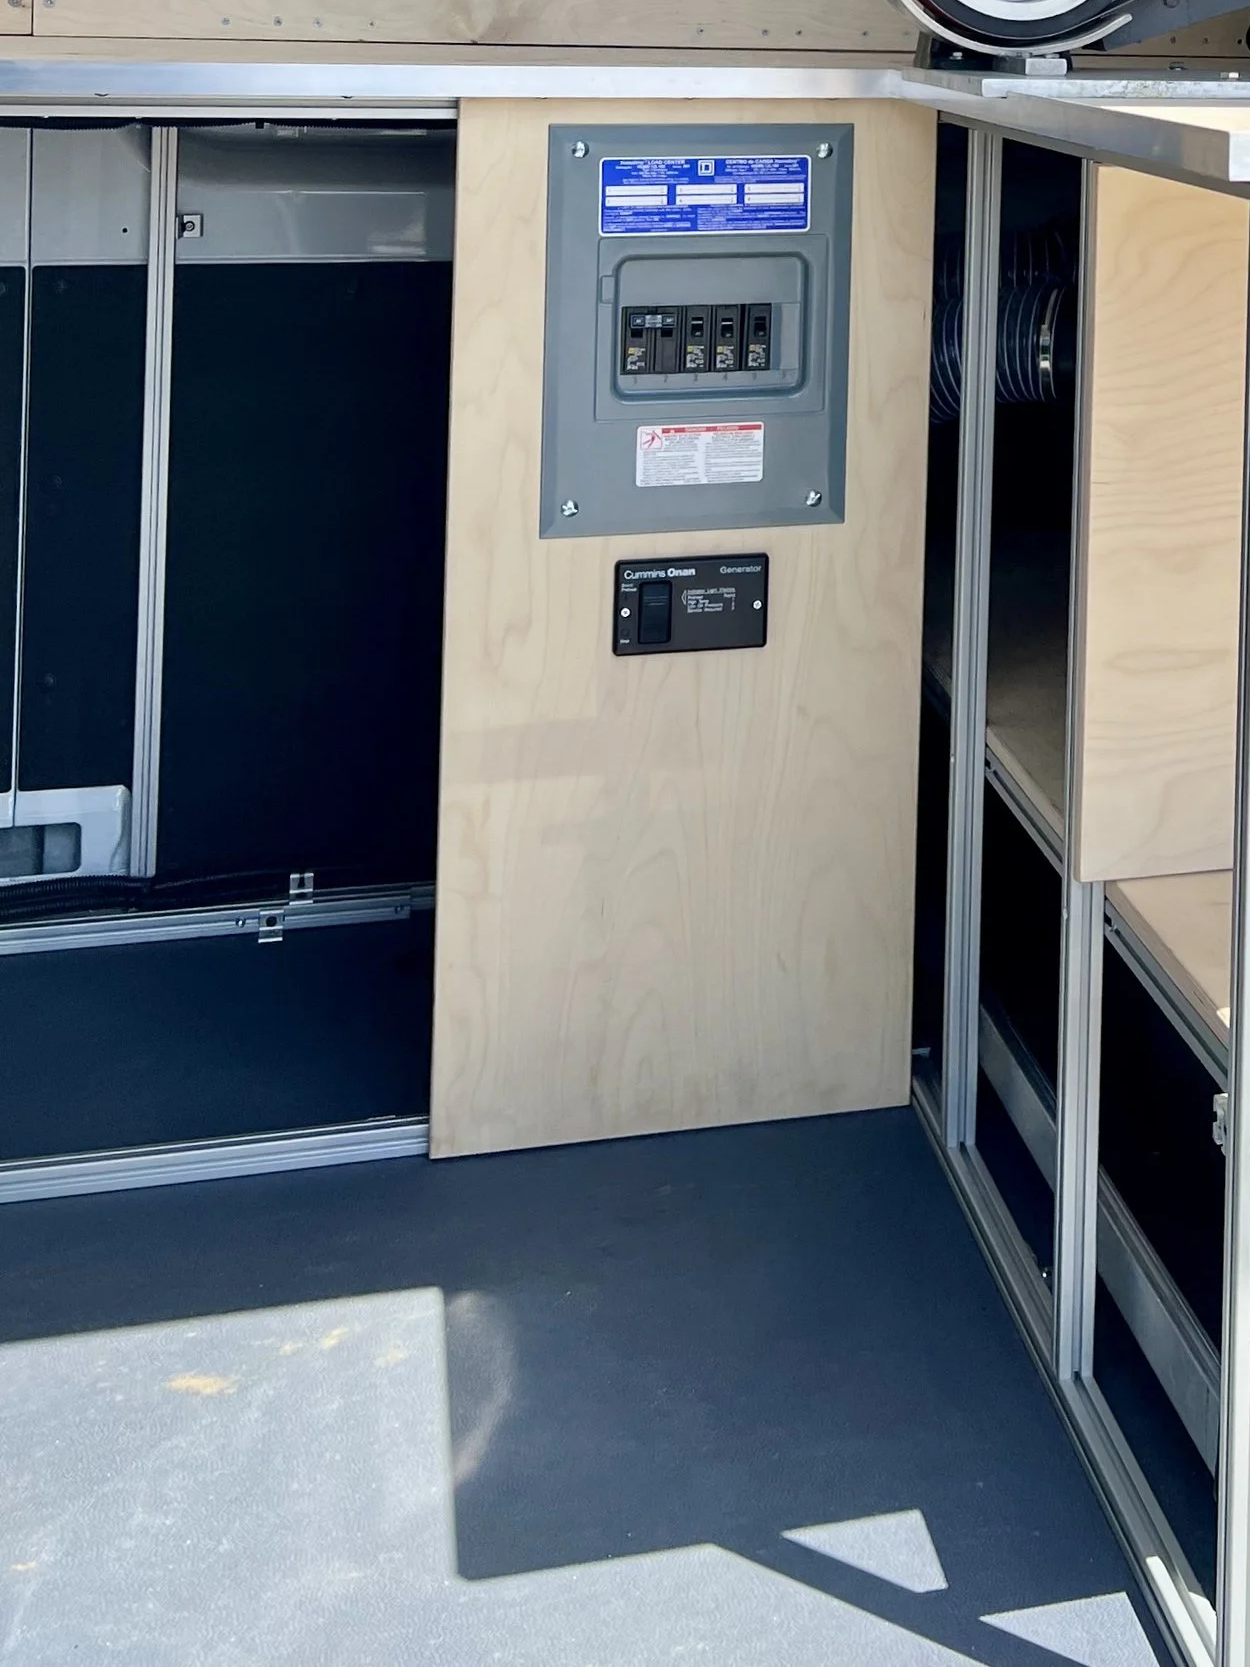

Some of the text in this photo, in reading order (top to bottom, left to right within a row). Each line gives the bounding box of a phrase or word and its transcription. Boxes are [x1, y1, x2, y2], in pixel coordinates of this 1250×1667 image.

[624, 568, 696, 580] Cummins Onan
[719, 565, 762, 574] Generator
